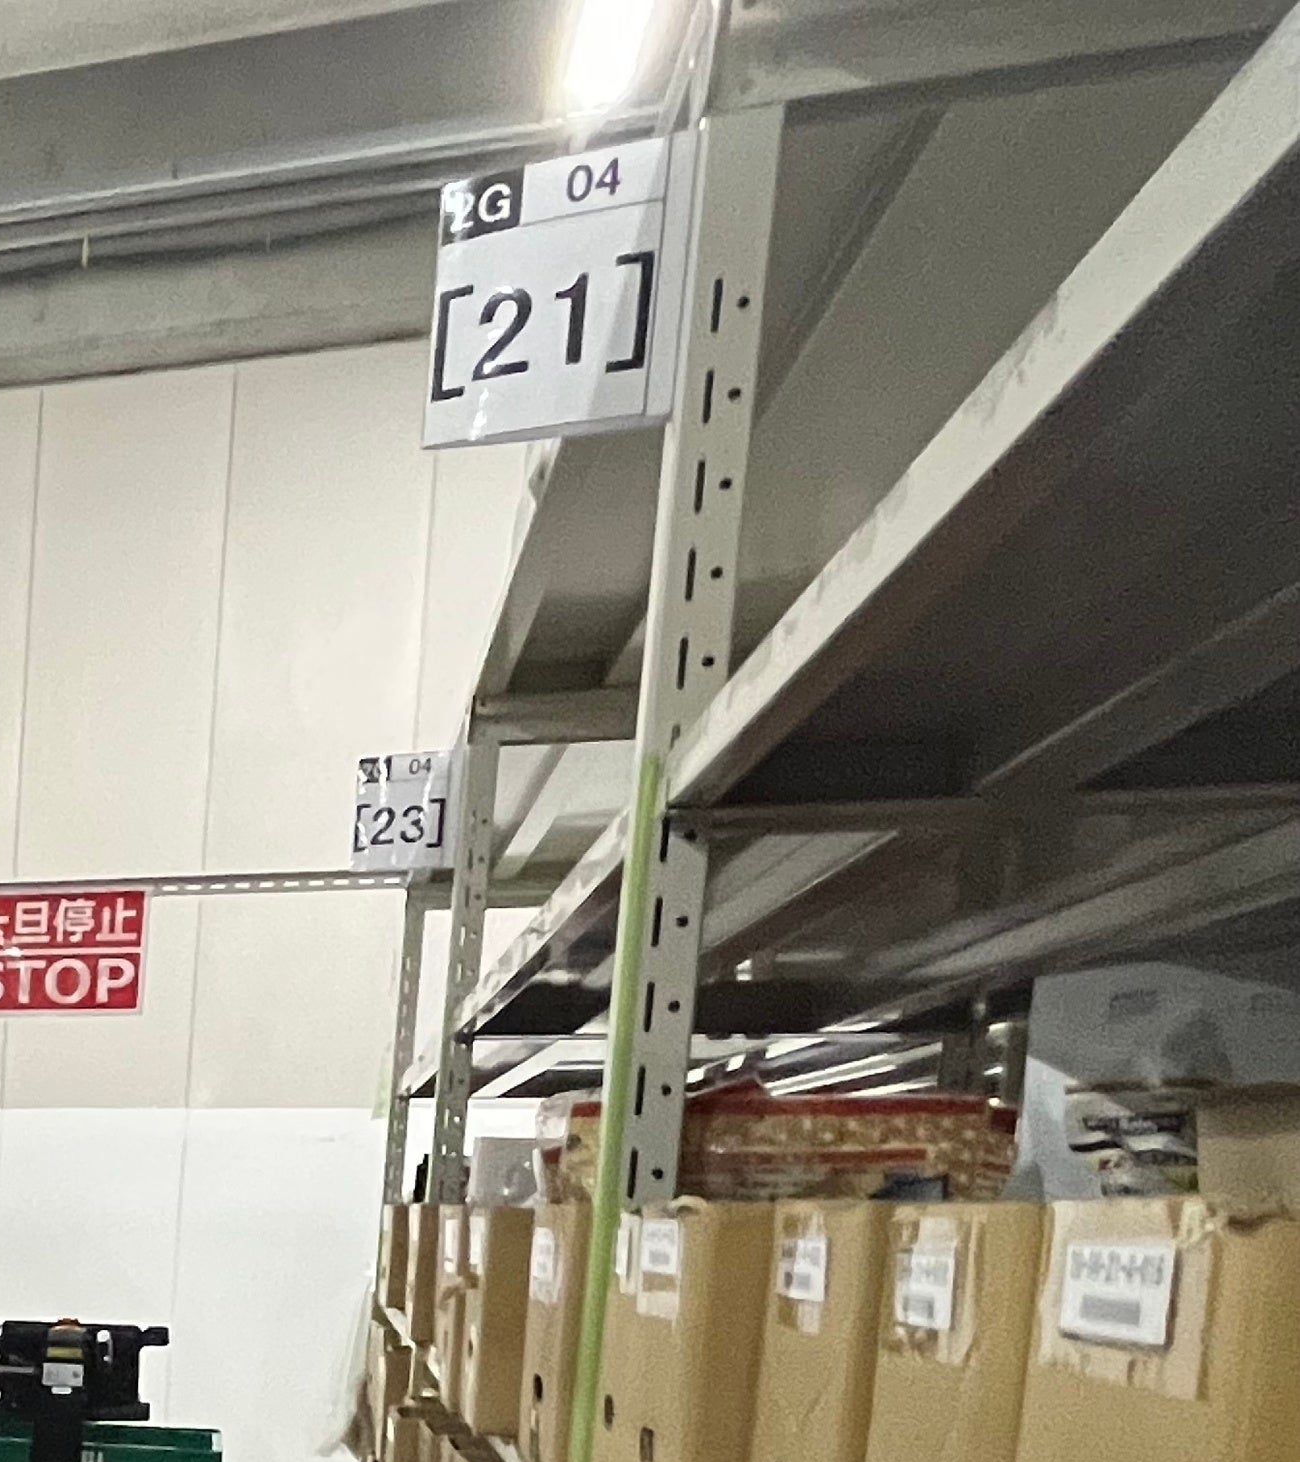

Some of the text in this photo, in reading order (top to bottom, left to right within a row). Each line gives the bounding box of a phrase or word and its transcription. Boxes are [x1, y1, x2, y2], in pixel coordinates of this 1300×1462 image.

[566, 156, 621, 202] 04
[430, 250, 655, 403] [21]
[409, 757, 431, 774] 04
[353, 797, 446, 852] [23]
